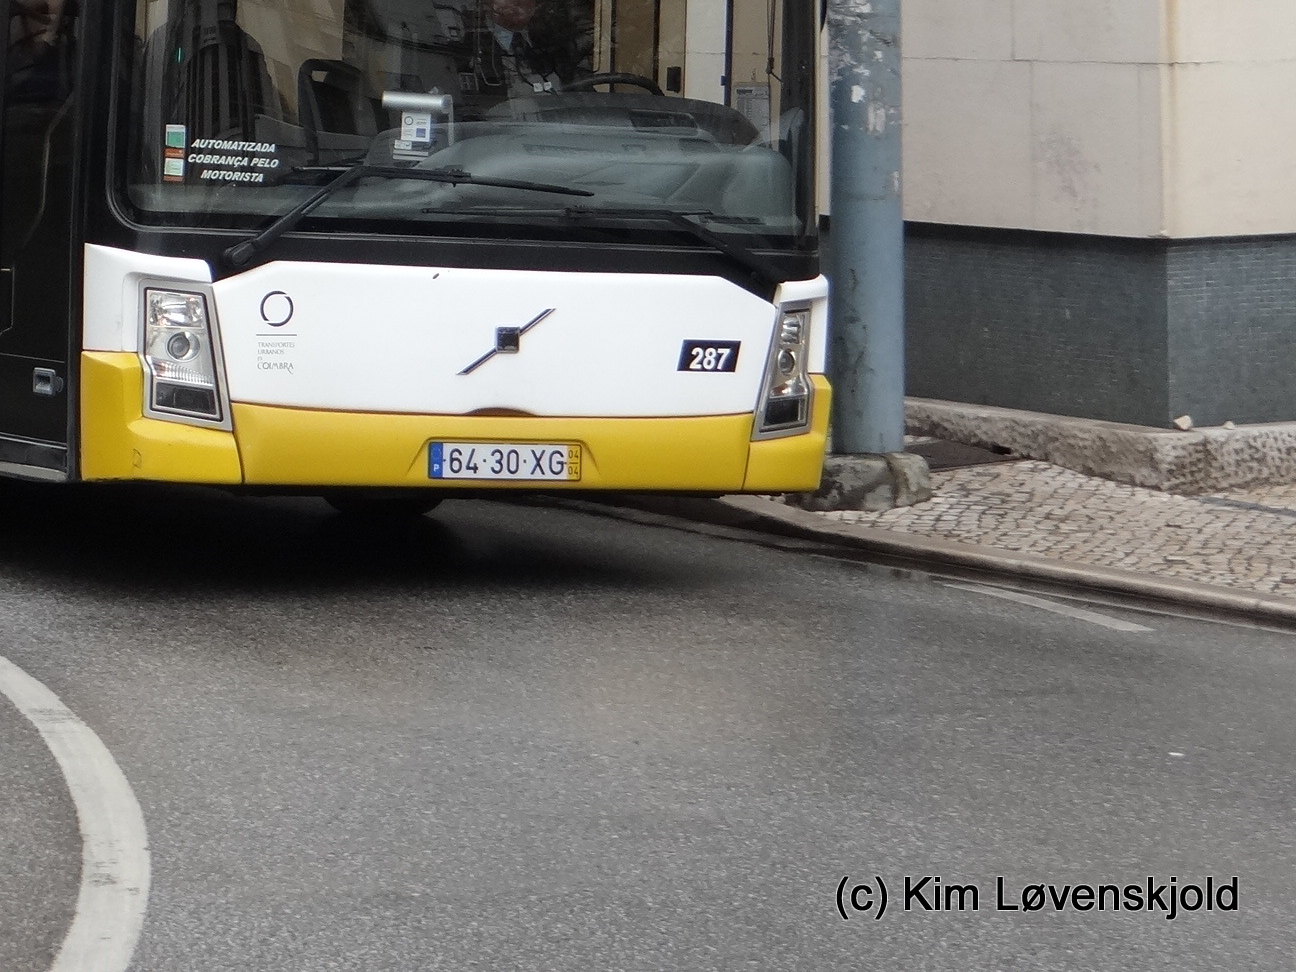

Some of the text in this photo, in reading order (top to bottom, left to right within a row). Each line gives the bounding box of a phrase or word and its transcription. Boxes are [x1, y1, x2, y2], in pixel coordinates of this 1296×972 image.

[190, 138, 276, 153] AUTOMATIZADA
[187, 153, 249, 168] COBRANÇA
[250, 157, 279, 168] PELO
[200, 169, 264, 182] MOTORISTA
[688, 347, 731, 371] 287
[568, 449, 579, 460] 04
[433, 463, 440, 472] P
[568, 466, 579, 475] 04
